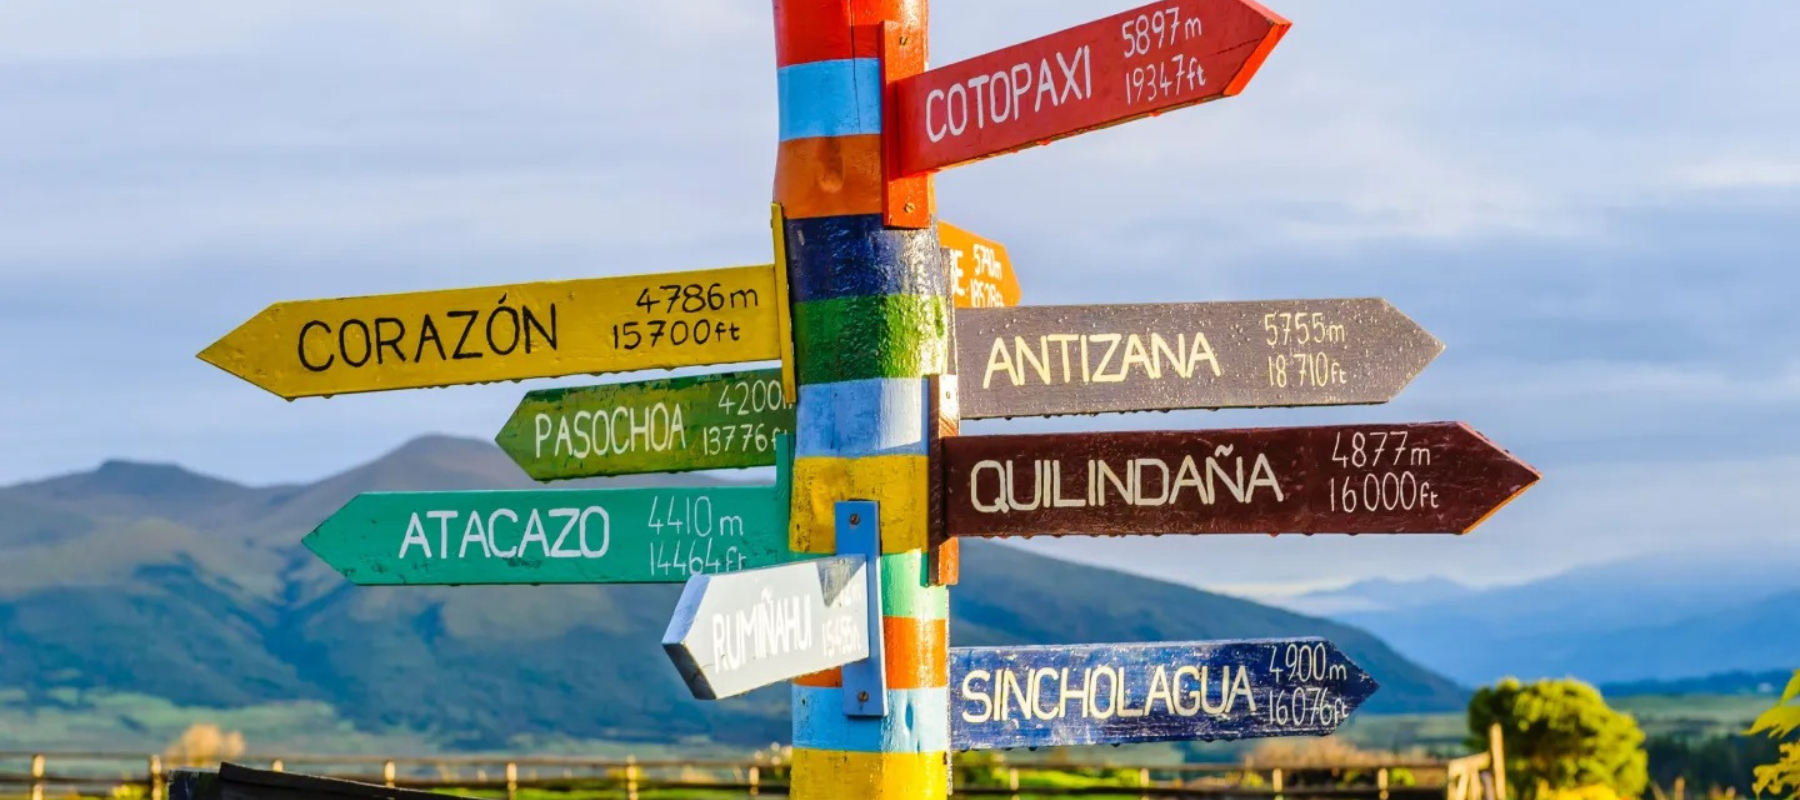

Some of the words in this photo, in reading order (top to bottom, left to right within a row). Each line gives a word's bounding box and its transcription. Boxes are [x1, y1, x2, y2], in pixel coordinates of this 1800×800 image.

[925, 45, 1091, 143] COTOPAXI
[1125, 53, 1206, 105] 19347ft
[636, 282, 759, 314] 4786m
[298, 292, 558, 372] CORAZÓN
[613, 318, 741, 350] 15700ft
[1263, 312, 1346, 346] 5755m
[983, 331, 1221, 388] ANTIZANA
[718, 379, 793, 416] 4200
[535, 403, 686, 459] PASOCHOA
[1330, 430, 1431, 470] 4877m
[969, 443, 1284, 514] QUILINDAÑA
[398, 504, 610, 559] ATACAZO
[712, 584, 812, 674] RUMIÑAHUI
[961, 664, 1257, 724] SINCHOLAGUA
